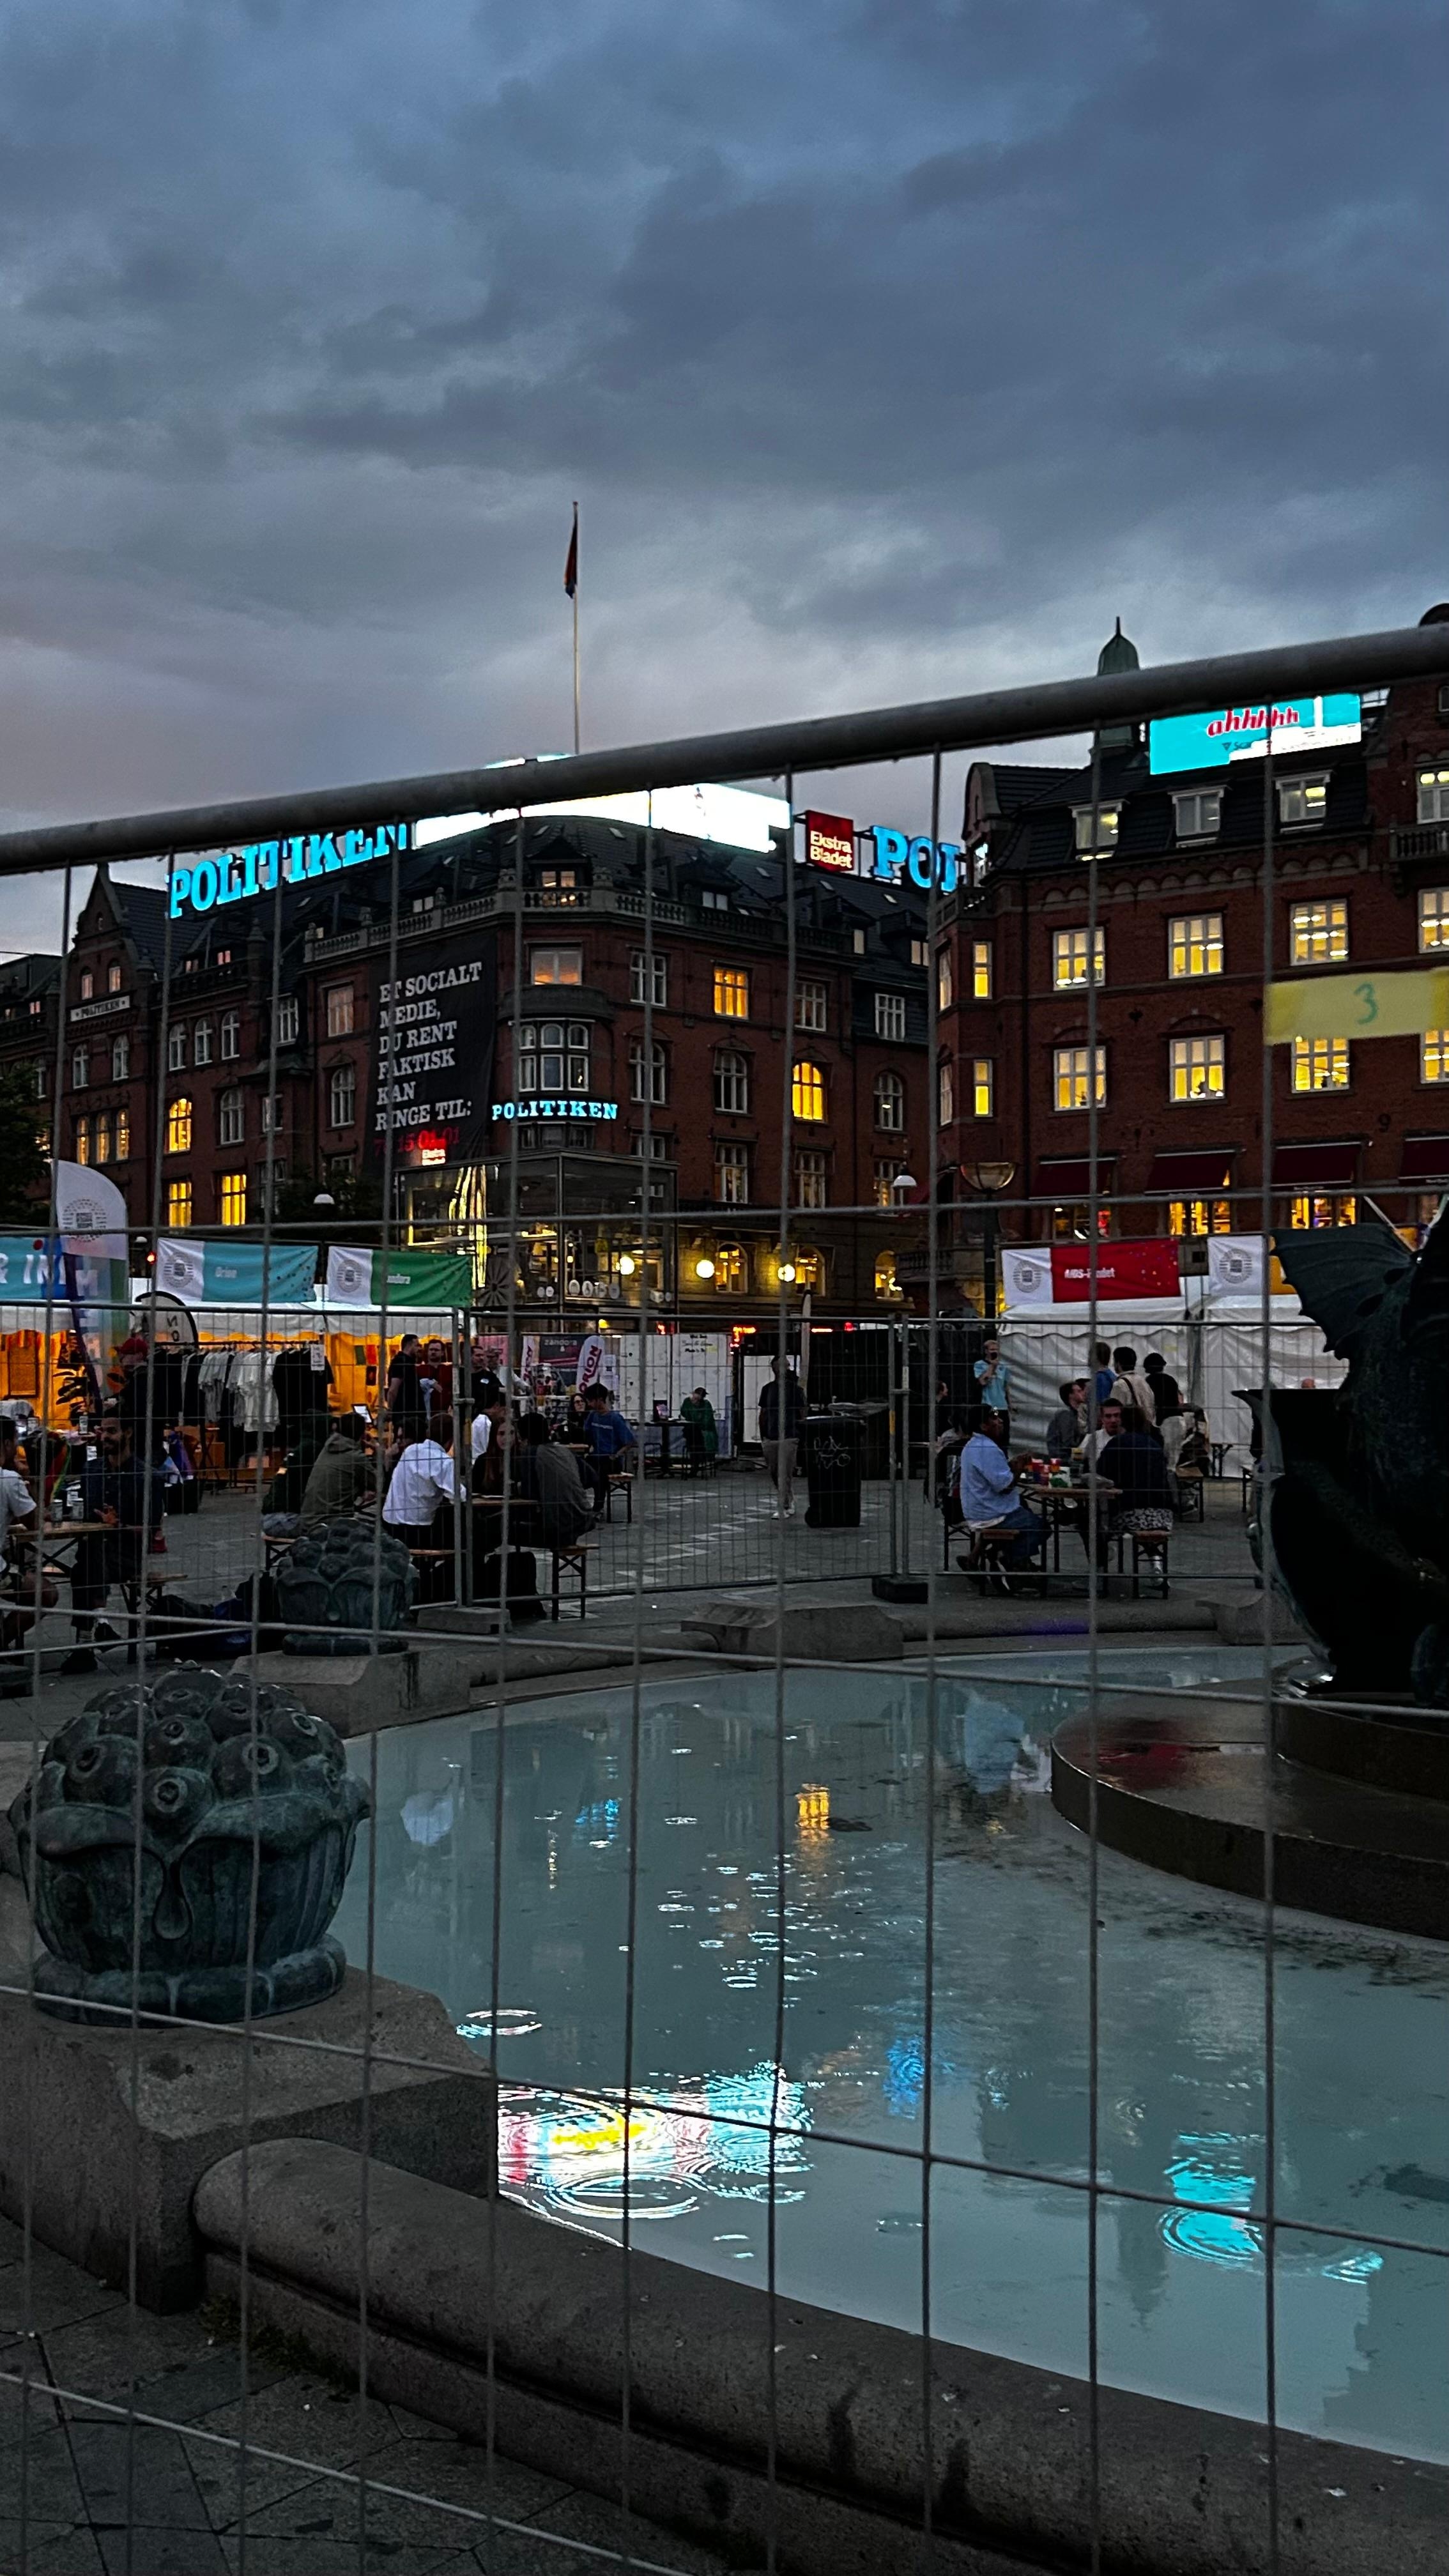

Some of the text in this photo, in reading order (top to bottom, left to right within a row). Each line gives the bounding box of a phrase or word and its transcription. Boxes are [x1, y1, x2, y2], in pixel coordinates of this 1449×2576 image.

[810, 831, 852, 854] Ekstra
[810, 845, 852, 869] Bladet
[379, 962, 482, 1003] ET SOCIALT
[1354, 981, 1379, 1025] 3
[379, 1020, 457, 1054] DU RENT
[378, 1047, 456, 1080] FAKTISK
[377, 1081, 417, 1106] KAN
[435, 1099, 472, 1120] TIL:
[492, 1100, 618, 1121] POLITIKEN
[579, 1344, 599, 1393] ORION
